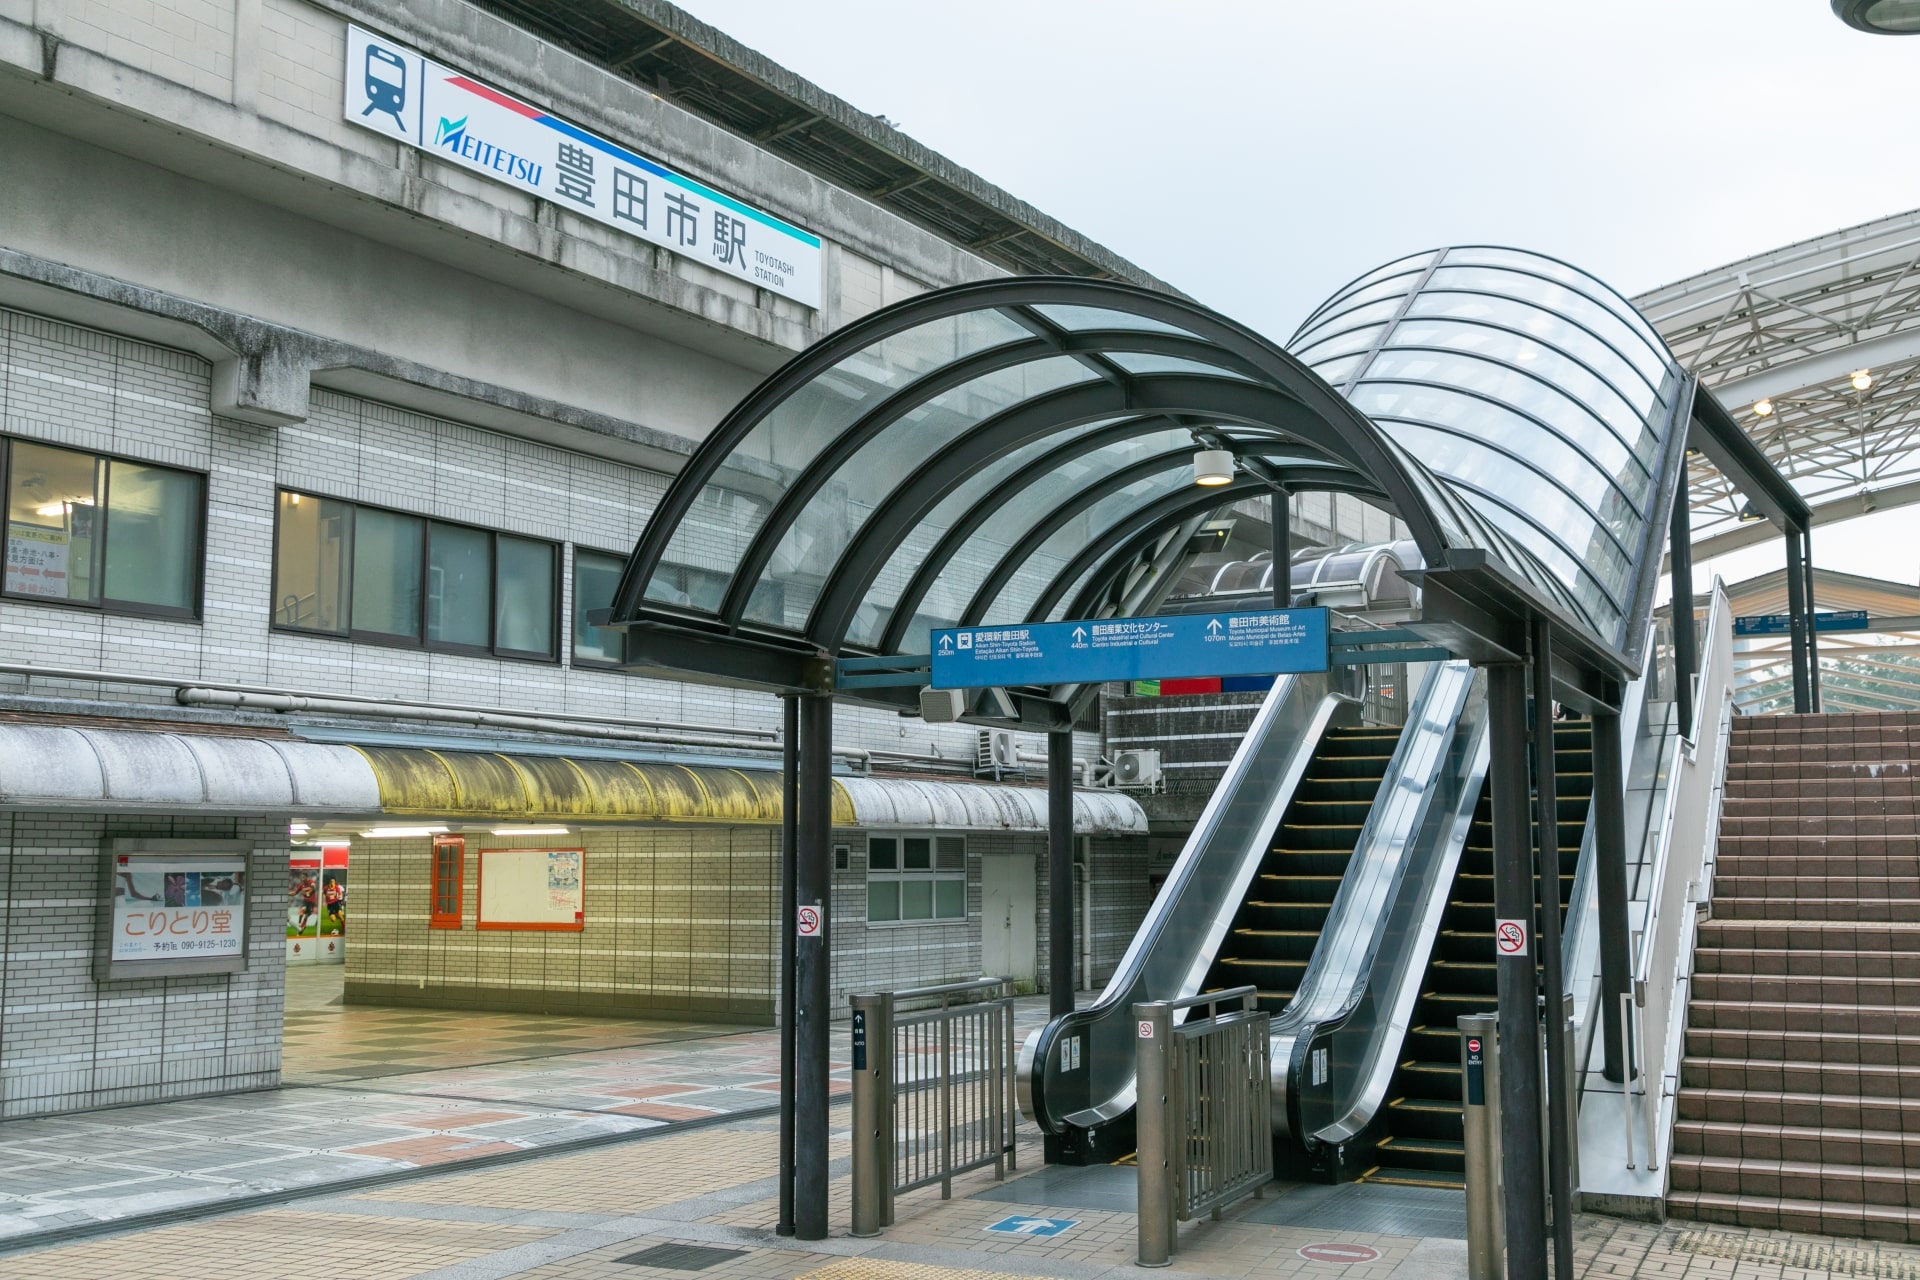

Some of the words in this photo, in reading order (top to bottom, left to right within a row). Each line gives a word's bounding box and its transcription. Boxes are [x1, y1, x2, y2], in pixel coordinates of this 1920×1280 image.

[434, 114, 543, 187] MEITETSU
[555, 142, 747, 271] 豊田市駅
[755, 250, 795, 276] TOYOTASHI
[755, 266, 784, 288] STATION
[1092, 622, 1168, 635] 豊田産業文化センター
[1228, 614, 1290, 628] 豊田市美術館
[975, 630, 1029, 642] 愛環新豊田駅
[125, 910, 232, 936] こりとり堂
[181, 939, 237, 950] 090-9125-1230
